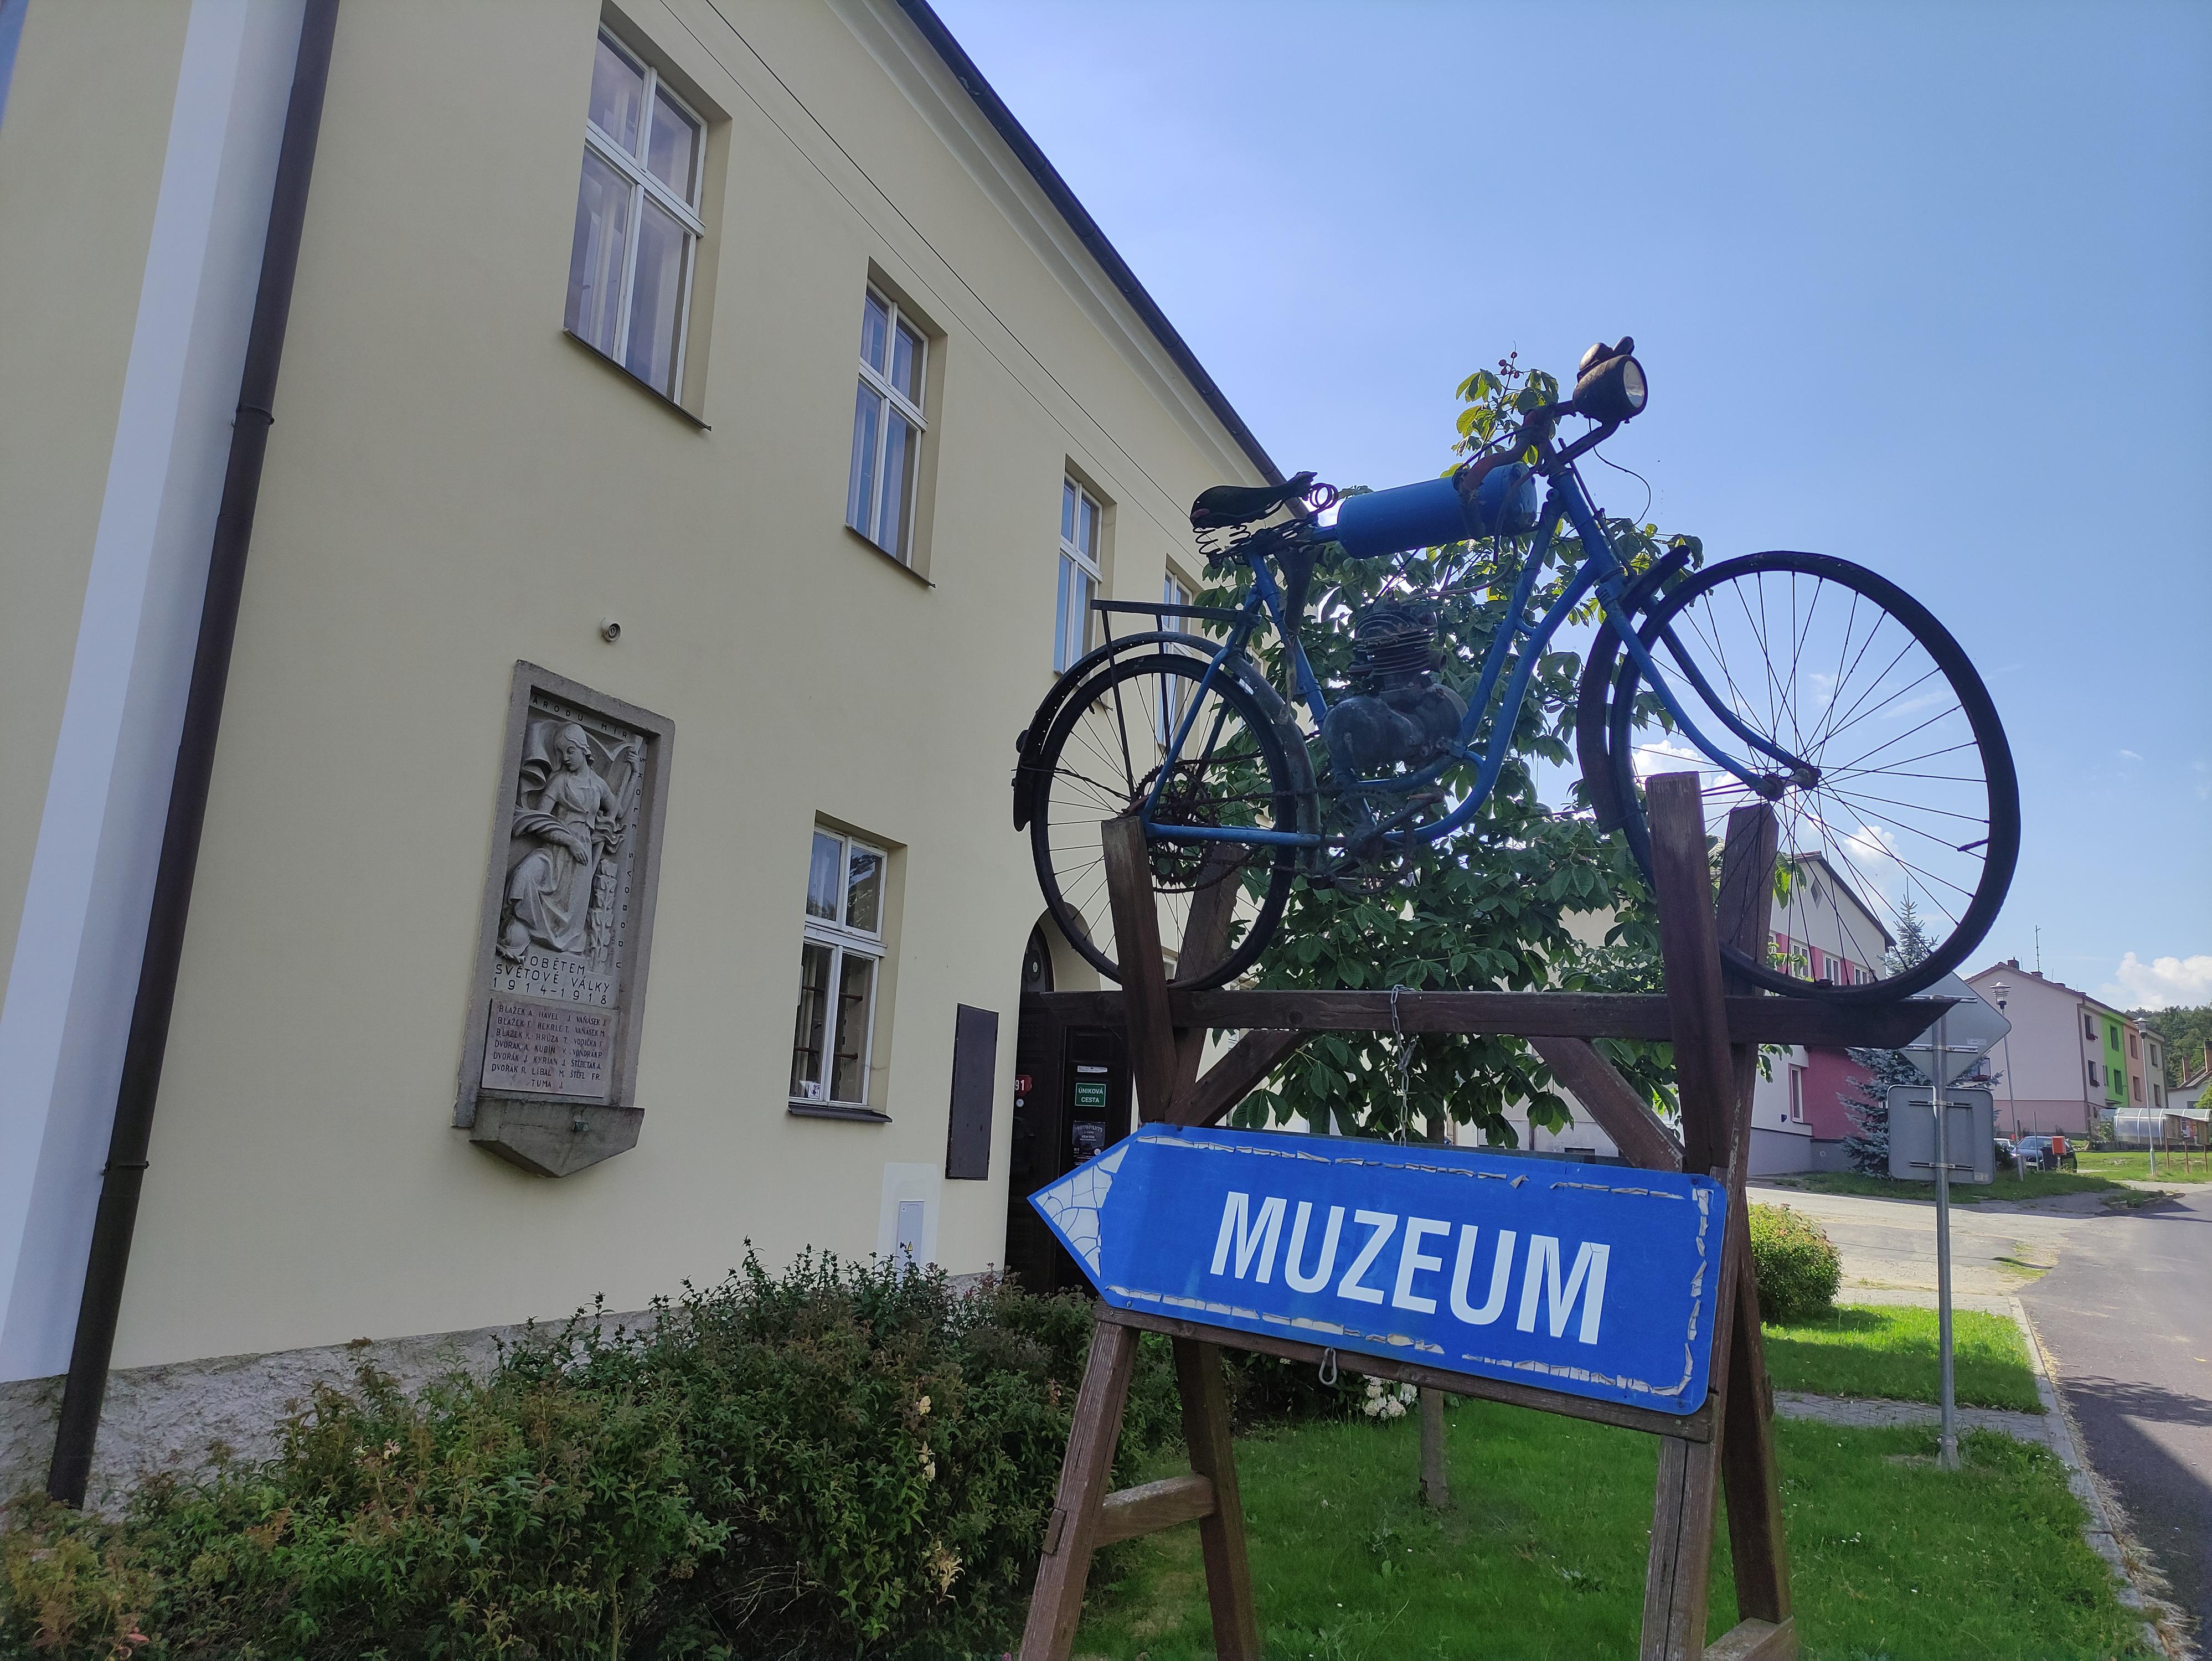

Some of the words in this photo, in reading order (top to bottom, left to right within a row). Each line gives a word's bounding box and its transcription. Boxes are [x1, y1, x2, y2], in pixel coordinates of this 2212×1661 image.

[532, 696, 583, 721] ÁRODU
[601, 723, 627, 739] MÍR
[632, 757, 646, 830] ŠKOLE
[616, 852, 634, 968] SVOBODU
[530, 956, 586, 976] OBĚTEM
[495, 964, 560, 984] SVĚTOVÉ
[571, 976, 610, 993] VÁLKY
[499, 1005, 525, 1015] BLAŽEK
[539, 1011, 559, 1020] HAVEL
[498, 1017, 524, 1027] BLAŽEK
[537, 1022, 563, 1032] HEKRLE
[496, 1028, 523, 1039] BLAŽEK
[574, 1038, 596, 1047] VODIČKA
[534, 1044, 555, 1054] KUBÍN
[493, 1051, 519, 1061] DVOŘÁK
[533, 1056, 558, 1065] KYRIAN
[532, 1067, 551, 1076] LÍBAL
[1078, 1086, 1104, 1095] ÚNIKOVÁ
[1209, 1191, 1610, 1345] MUZEUM
